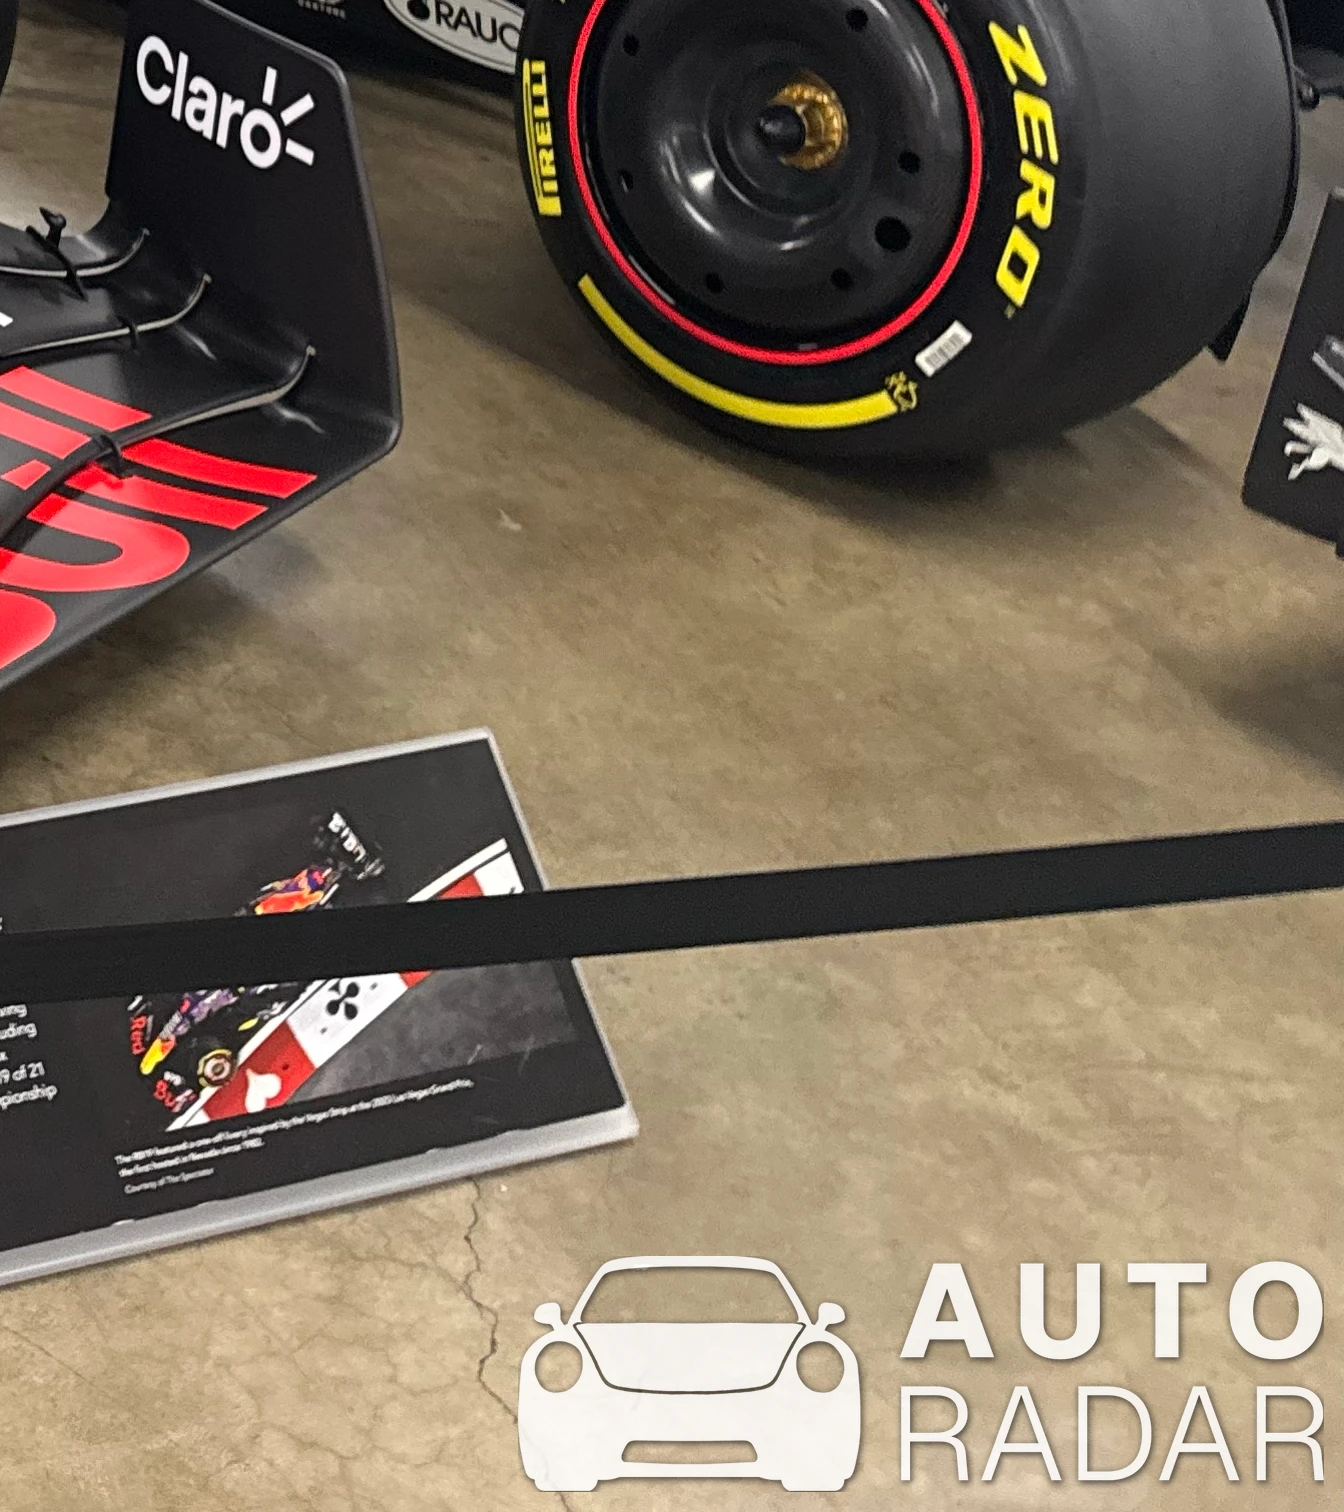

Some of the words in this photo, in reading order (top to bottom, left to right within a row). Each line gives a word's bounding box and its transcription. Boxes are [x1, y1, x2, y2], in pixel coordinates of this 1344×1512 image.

[136, 34, 283, 170] Claro
[522, 59, 562, 216] PIRELLI
[988, 21, 1059, 308] ZERO
[12, 1065, 27, 1081] of
[27, 1061, 45, 1078] 21
